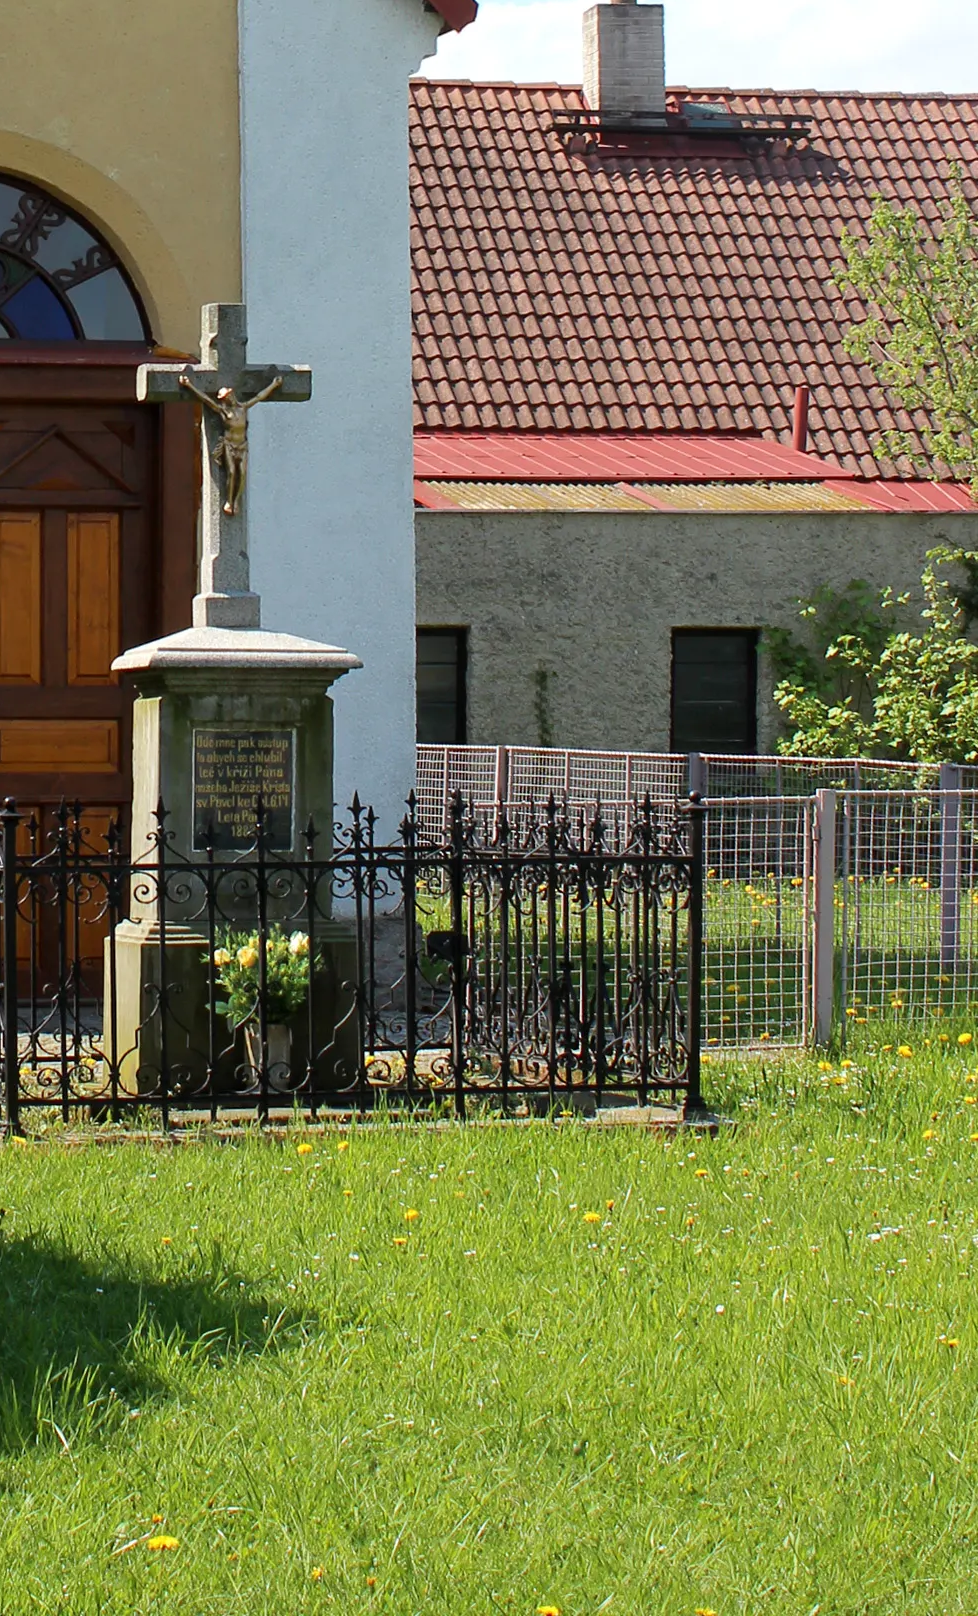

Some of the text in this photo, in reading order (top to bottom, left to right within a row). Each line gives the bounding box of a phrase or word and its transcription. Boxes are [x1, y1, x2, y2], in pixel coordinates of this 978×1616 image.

[206, 750, 235, 765] abych
[218, 769, 224, 778] v
[237, 795, 250, 808] ke
